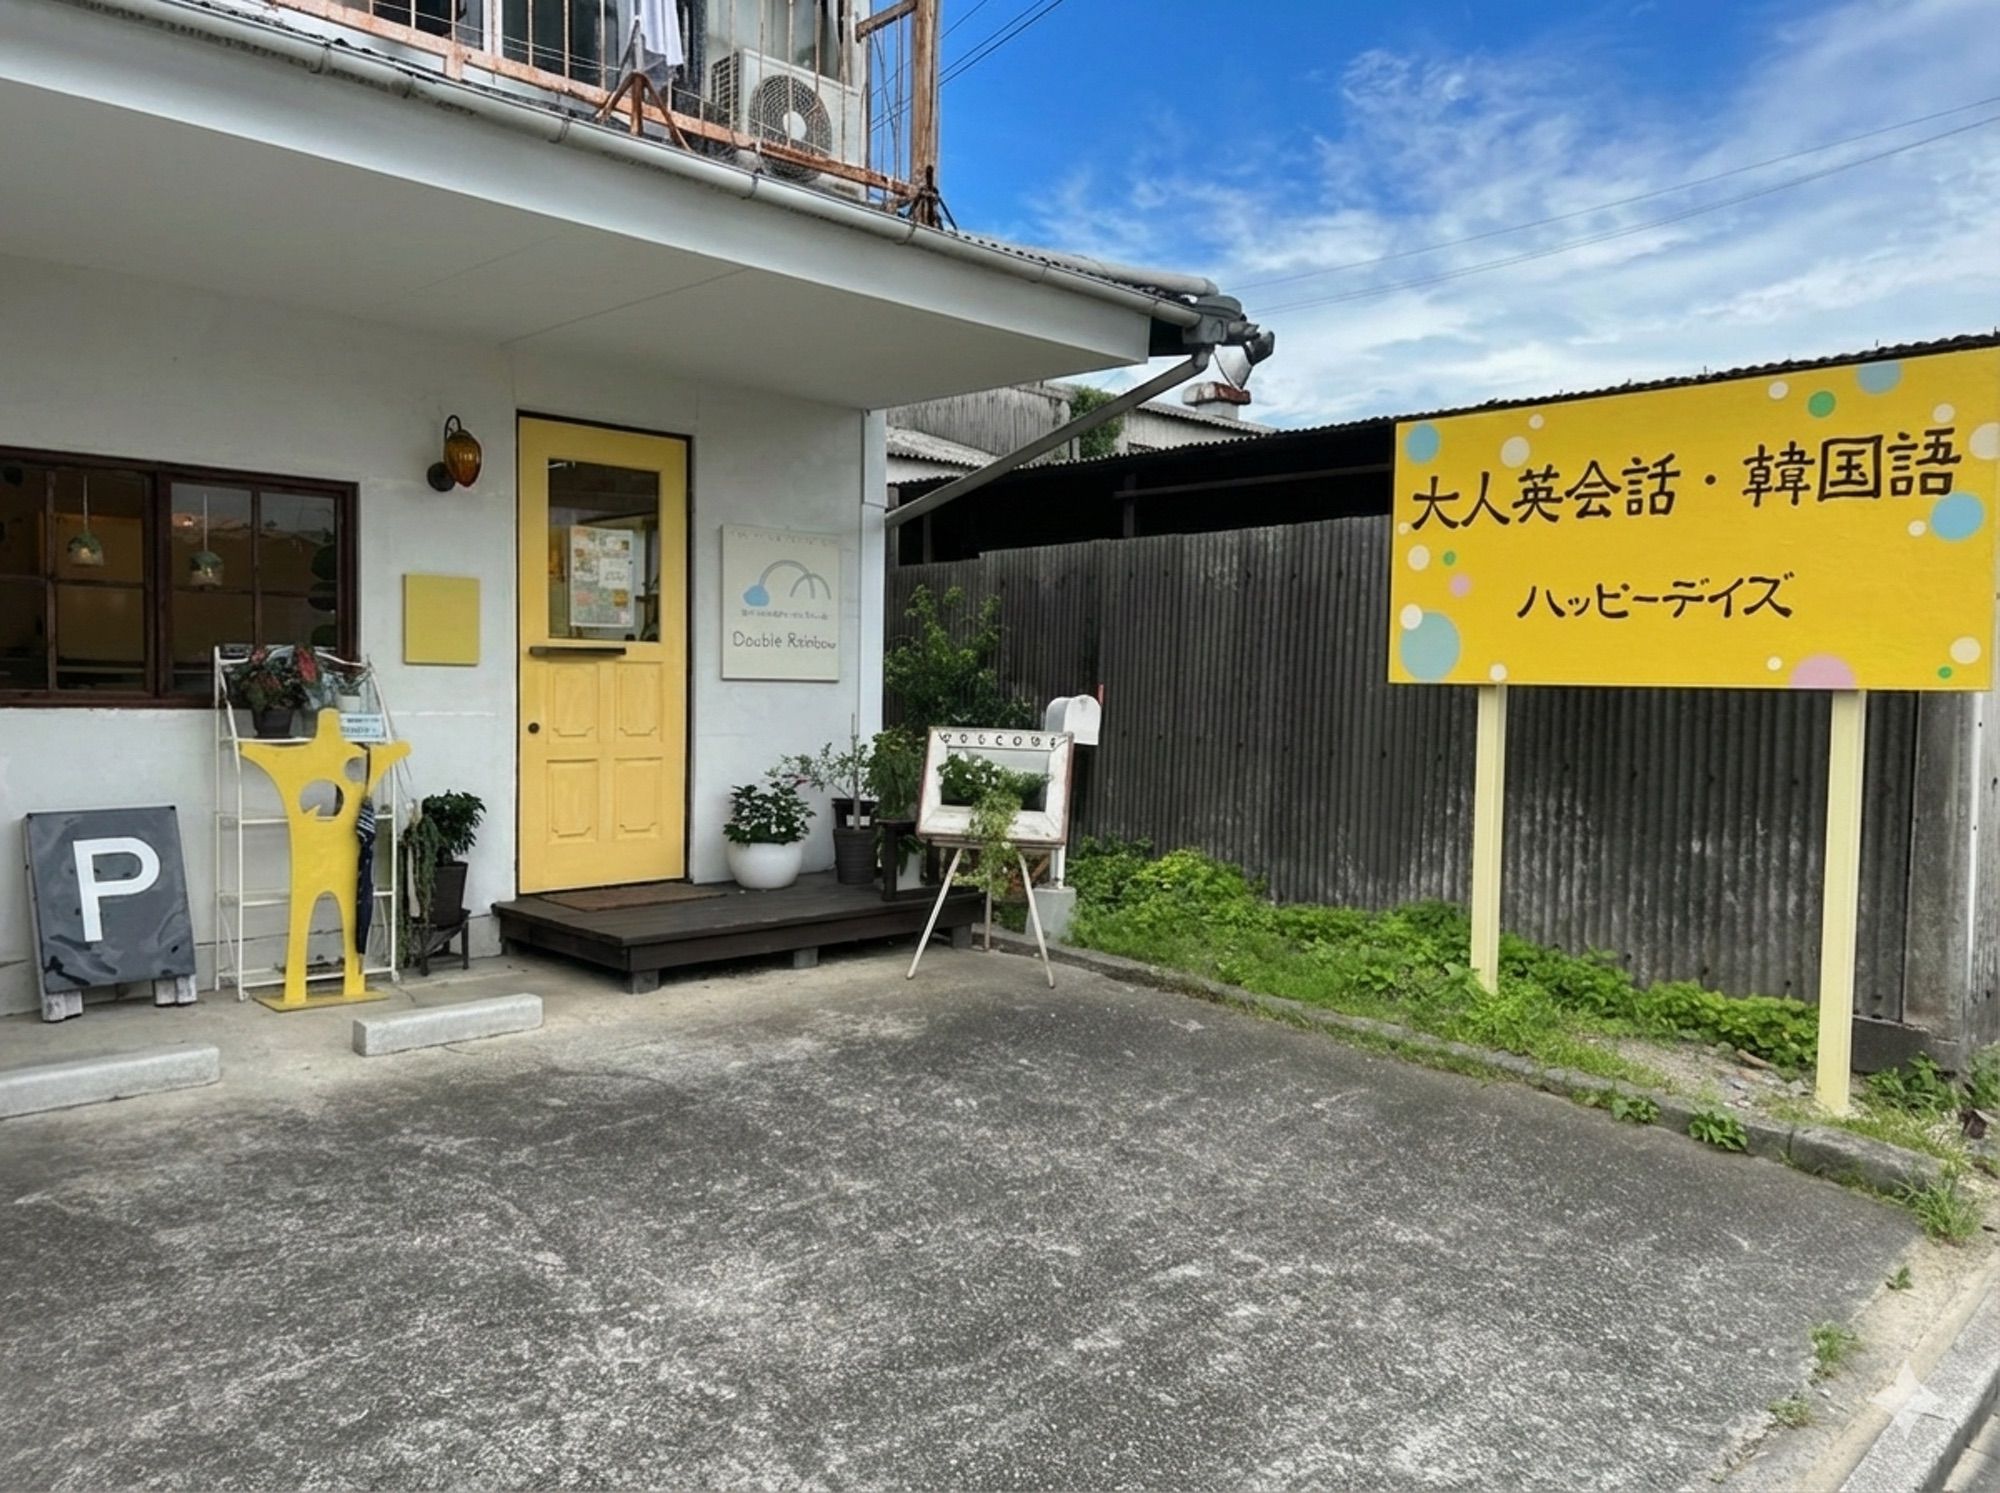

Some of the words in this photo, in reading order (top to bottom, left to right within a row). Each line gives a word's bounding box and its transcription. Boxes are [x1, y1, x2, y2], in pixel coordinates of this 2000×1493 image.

[1411, 426, 1962, 530] 大人英会話・韓国語
[1516, 570, 1796, 619] ハッピーデイズ
[72, 836, 161, 943] P
